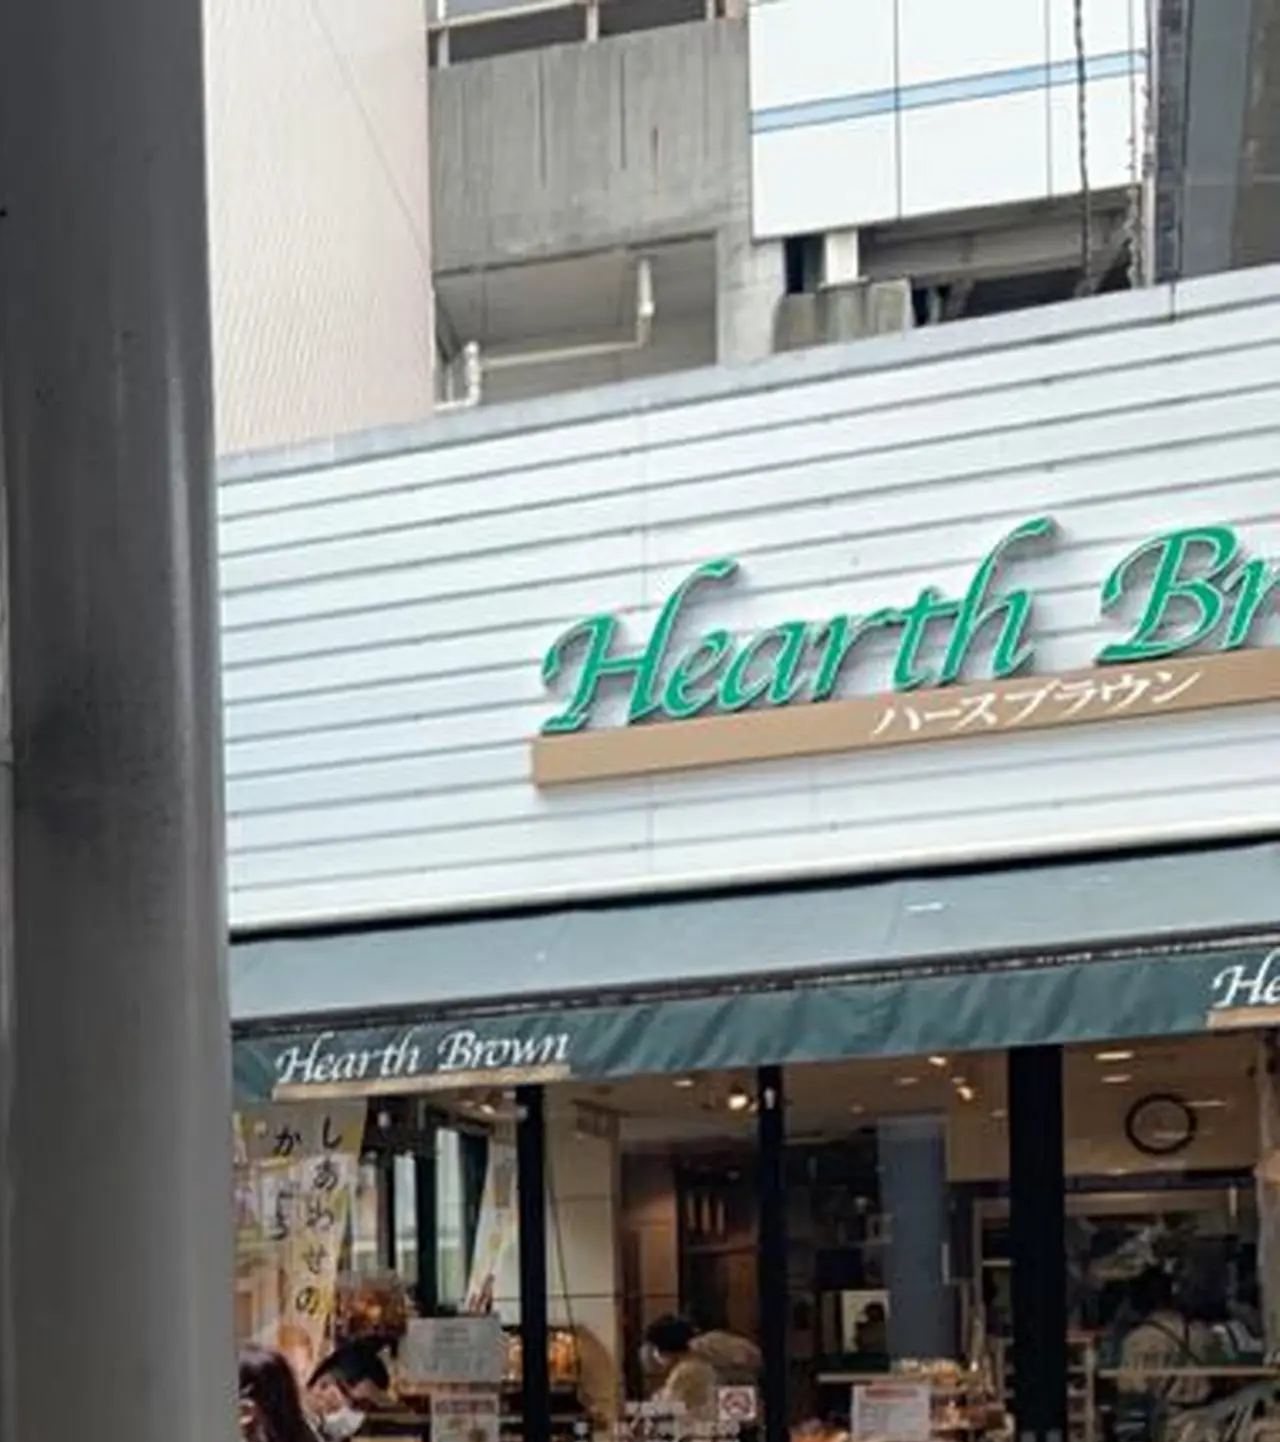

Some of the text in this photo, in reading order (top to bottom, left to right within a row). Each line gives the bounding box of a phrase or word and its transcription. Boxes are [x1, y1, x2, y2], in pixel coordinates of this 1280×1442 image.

[541, 516, 1054, 734] Hearth
[873, 669, 1202, 738] ハースブラウン
[274, 1025, 570, 1084] Hearth Brown
